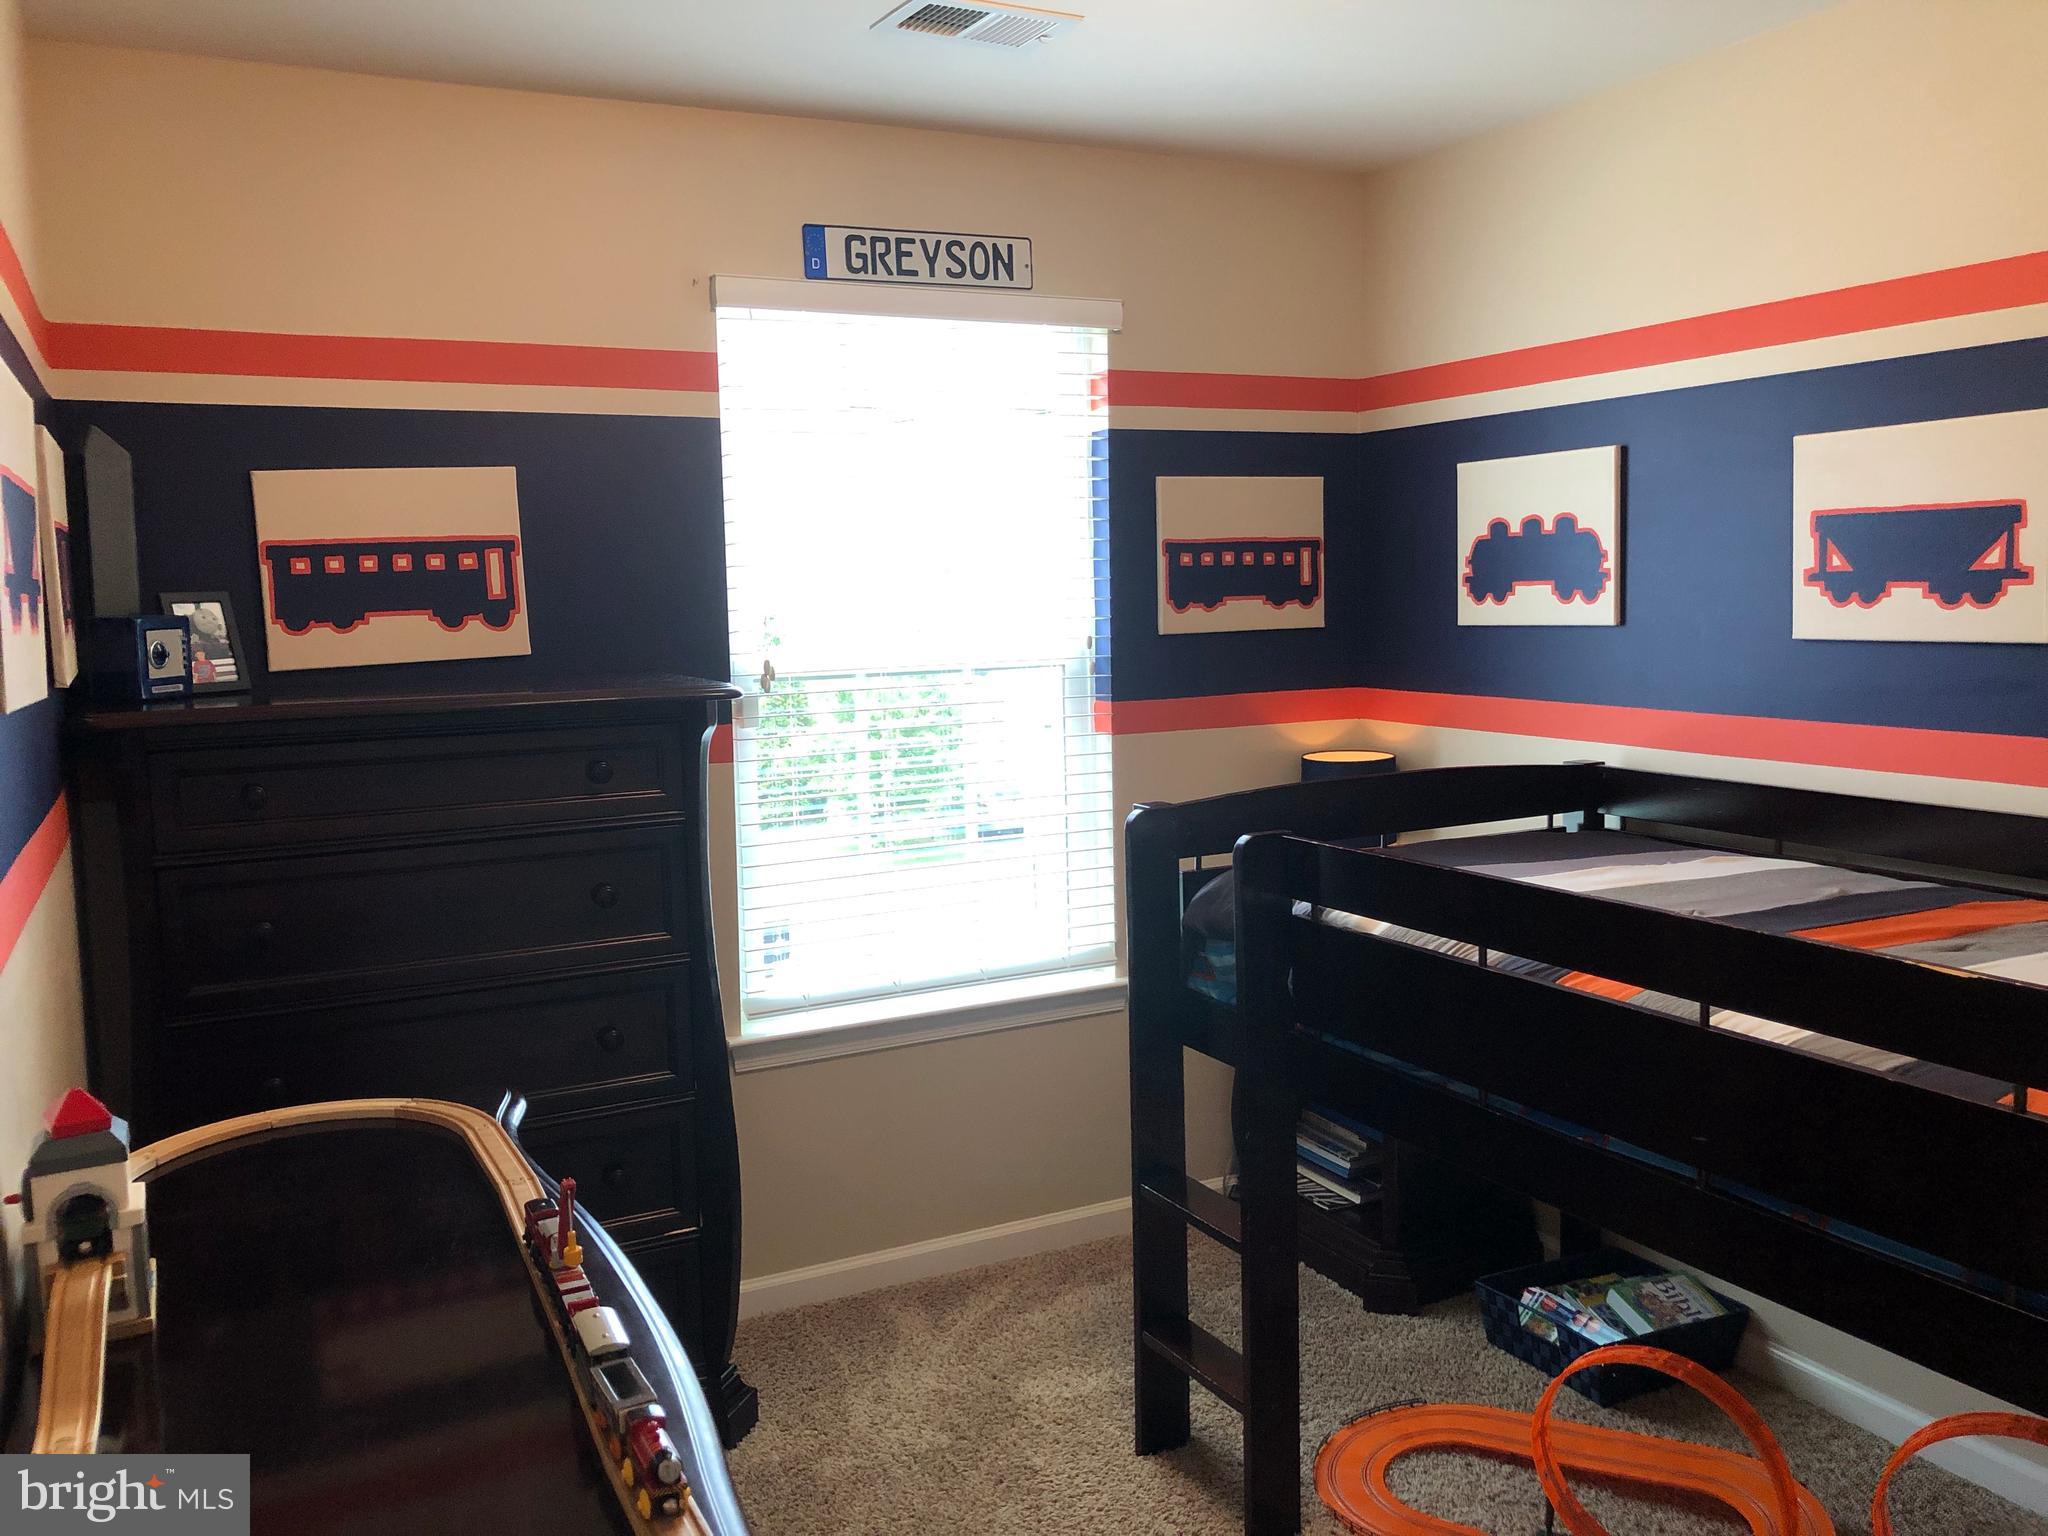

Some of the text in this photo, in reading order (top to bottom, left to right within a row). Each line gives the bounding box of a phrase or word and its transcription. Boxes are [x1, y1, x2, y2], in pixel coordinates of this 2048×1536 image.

[811, 234, 1014, 281] D GREYSON
[1649, 1279, 1703, 1318] Bibl
